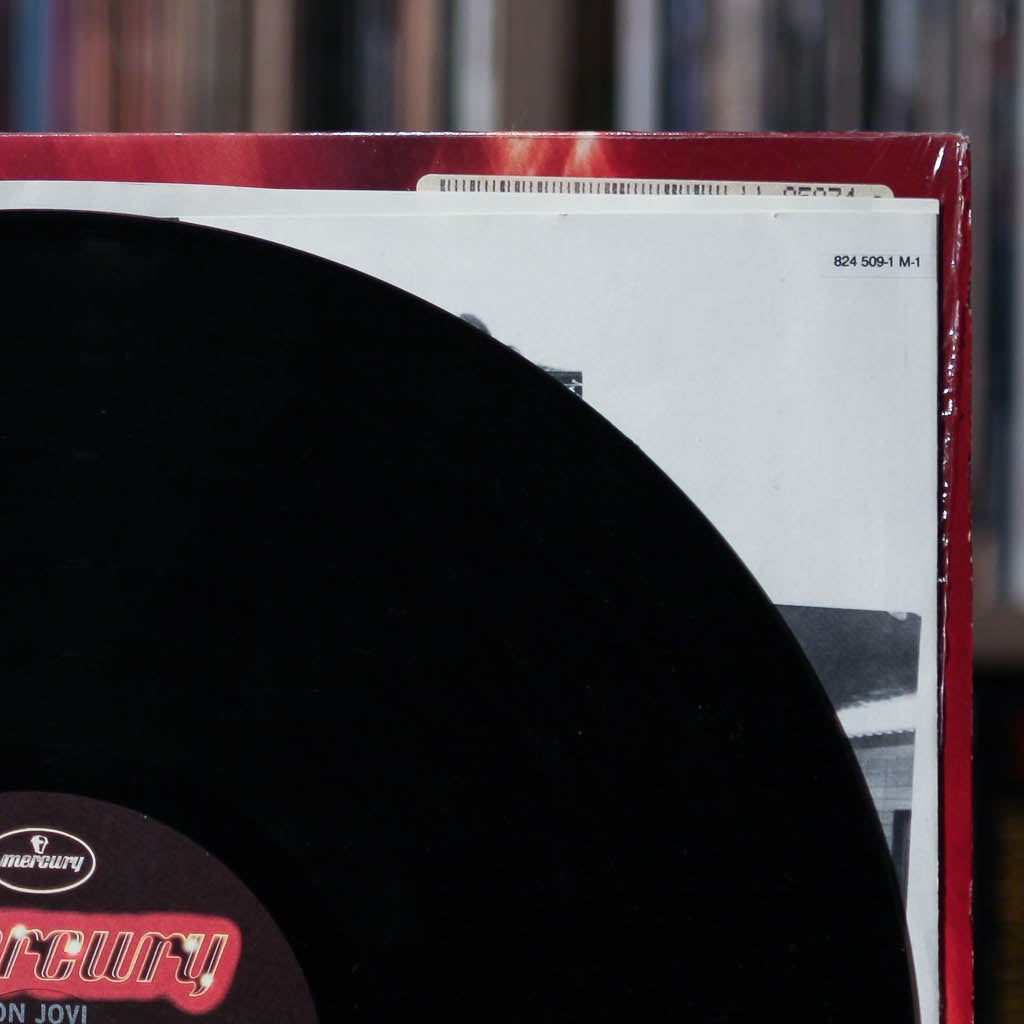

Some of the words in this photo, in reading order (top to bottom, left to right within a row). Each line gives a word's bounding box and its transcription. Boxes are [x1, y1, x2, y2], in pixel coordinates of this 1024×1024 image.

[834, 256, 857, 267] 824
[861, 256, 894, 267] 509-1
[899, 256, 920, 267] M-1
[35, 1003, 88, 1024] JOVI
